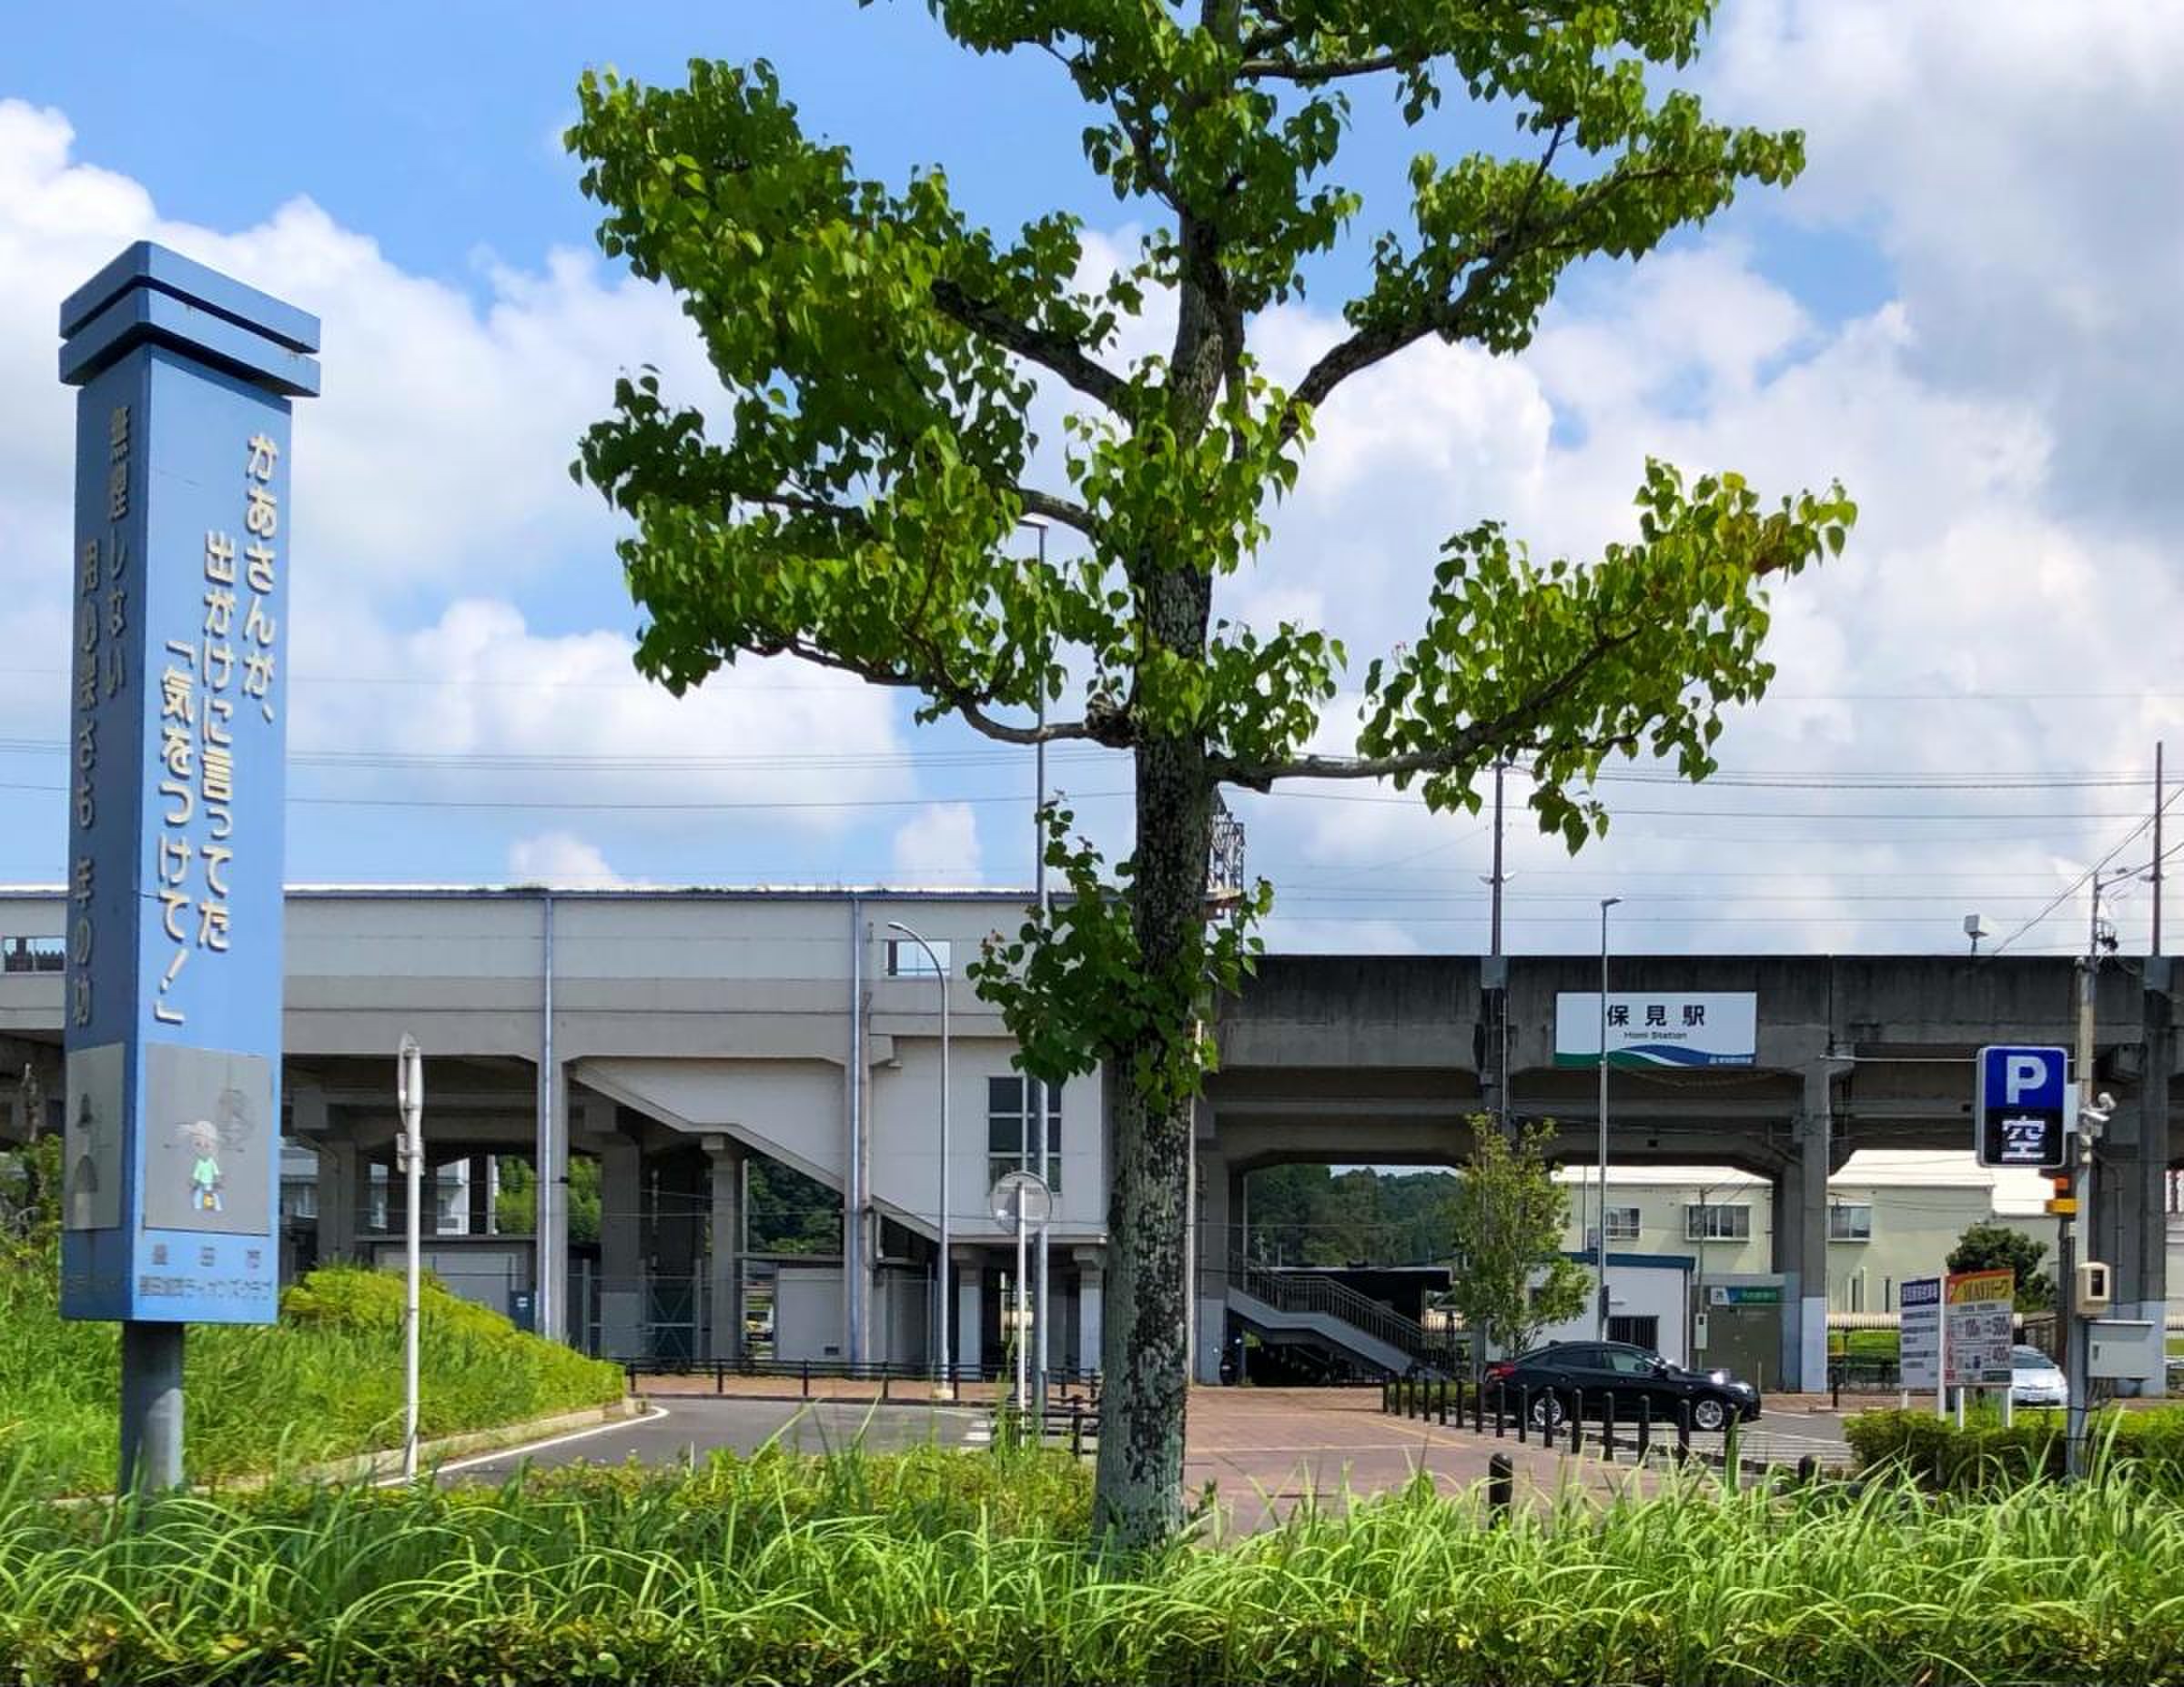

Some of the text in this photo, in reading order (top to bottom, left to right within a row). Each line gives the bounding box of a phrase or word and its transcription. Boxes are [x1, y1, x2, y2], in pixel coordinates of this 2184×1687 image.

[244, 433, 278, 724] かあさんが、
[197, 530, 235, 952] 出かけに言ってた
[155, 639, 195, 1025] 「気をつけて!」
[1606, 1004, 1705, 1027] 保見駅
[1652, 1031, 1688, 1039] Station
[2006, 1056, 2047, 1105] P
[2001, 1115, 2046, 1160] 空
